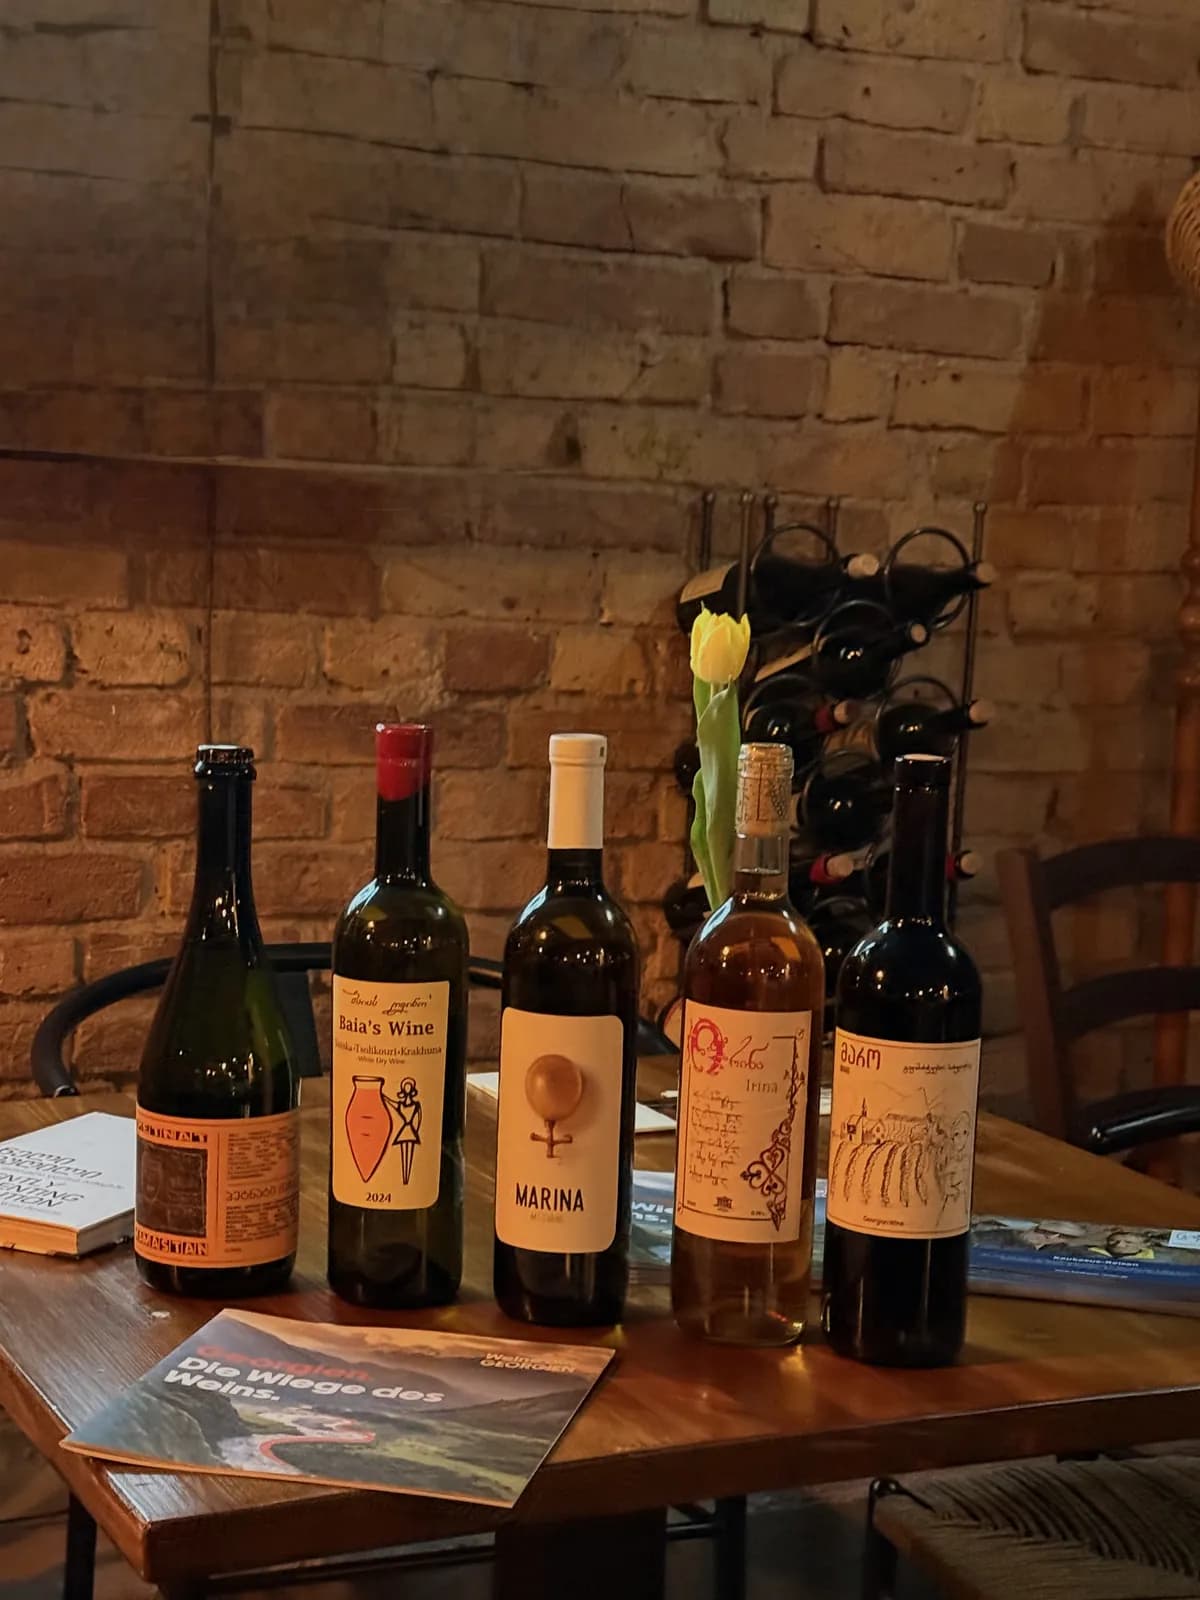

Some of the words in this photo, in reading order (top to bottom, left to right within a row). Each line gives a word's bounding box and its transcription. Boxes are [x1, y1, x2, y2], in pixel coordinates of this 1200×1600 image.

[339, 1015, 382, 1036] Baia's
[389, 1020, 434, 1037] Wine
[745, 1078, 779, 1094] Irina
[366, 1193, 392, 1203] 2024
[515, 1182, 584, 1212] MARINA
[480, 1359, 577, 1374] GEORGIEN
[163, 1369, 281, 1401] Weins.
[177, 1356, 241, 1378] Die
[246, 1369, 366, 1395] Wiege
[371, 1386, 445, 1402] des
